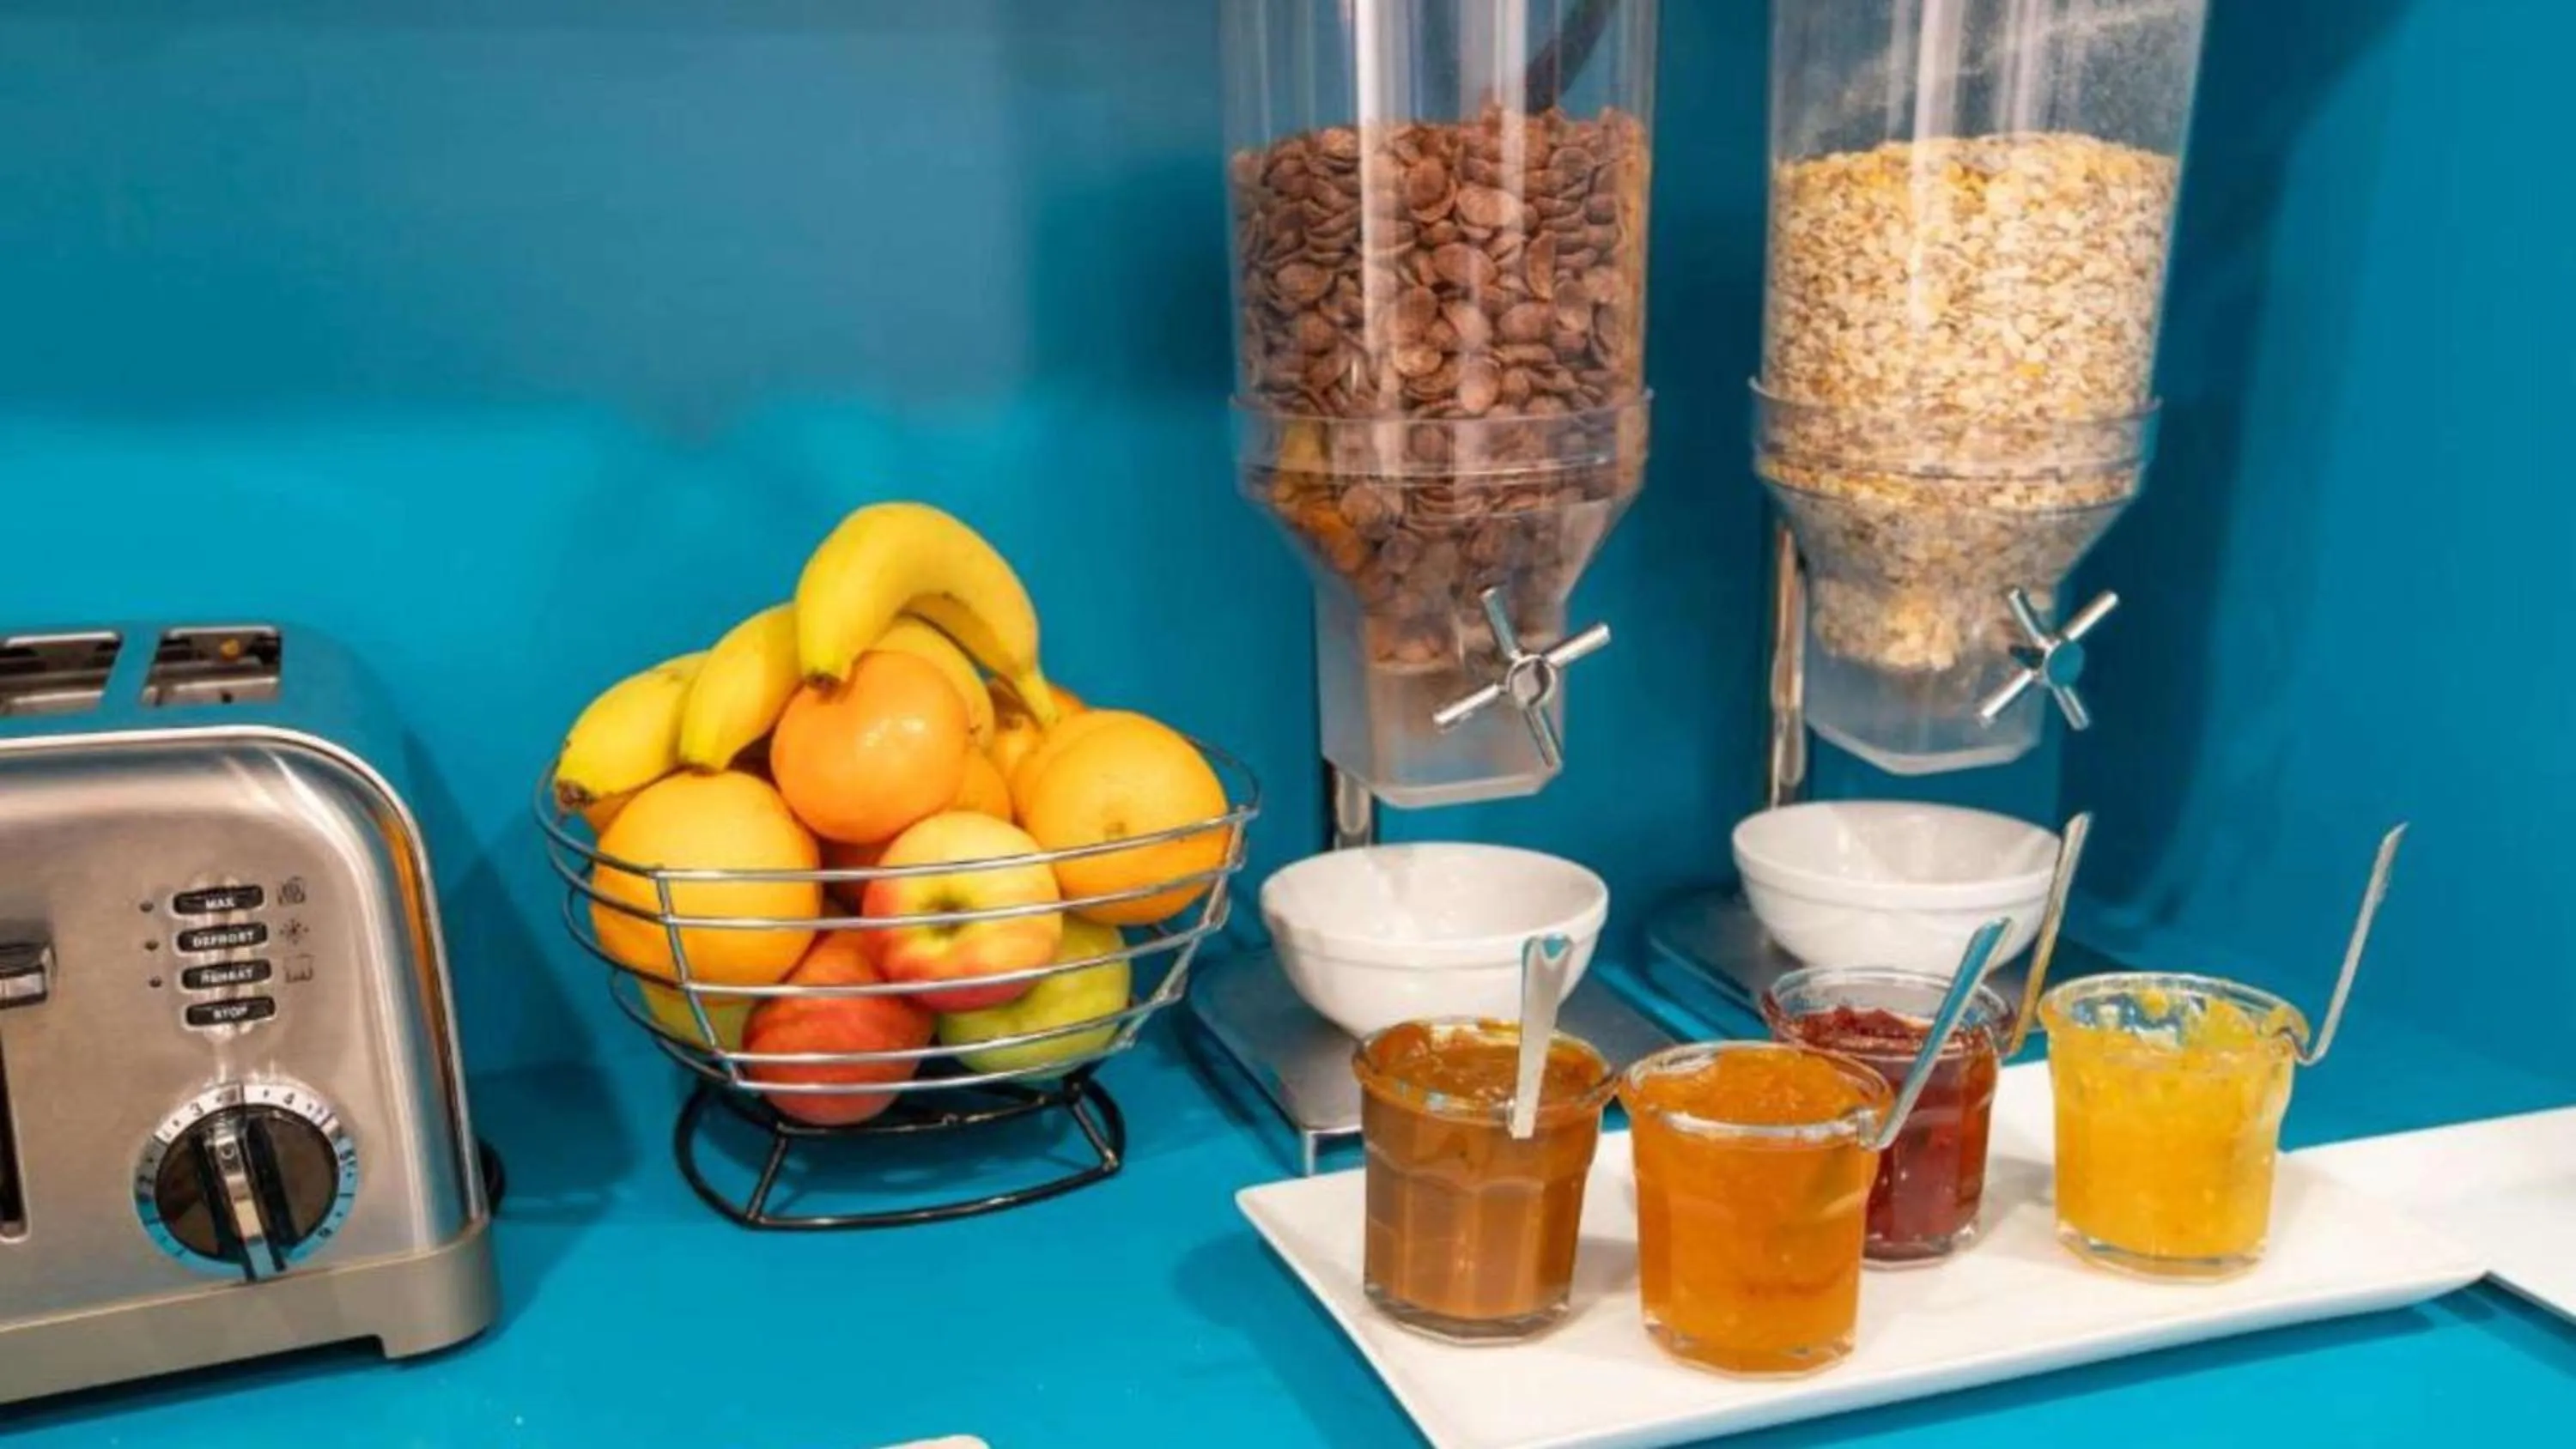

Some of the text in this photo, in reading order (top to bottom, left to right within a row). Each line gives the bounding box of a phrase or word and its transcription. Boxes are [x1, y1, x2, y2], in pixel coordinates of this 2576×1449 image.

[192, 931, 255, 948] DEFROST
[213, 1006, 248, 1020] STOP
[190, 1101, 204, 1117] 3
